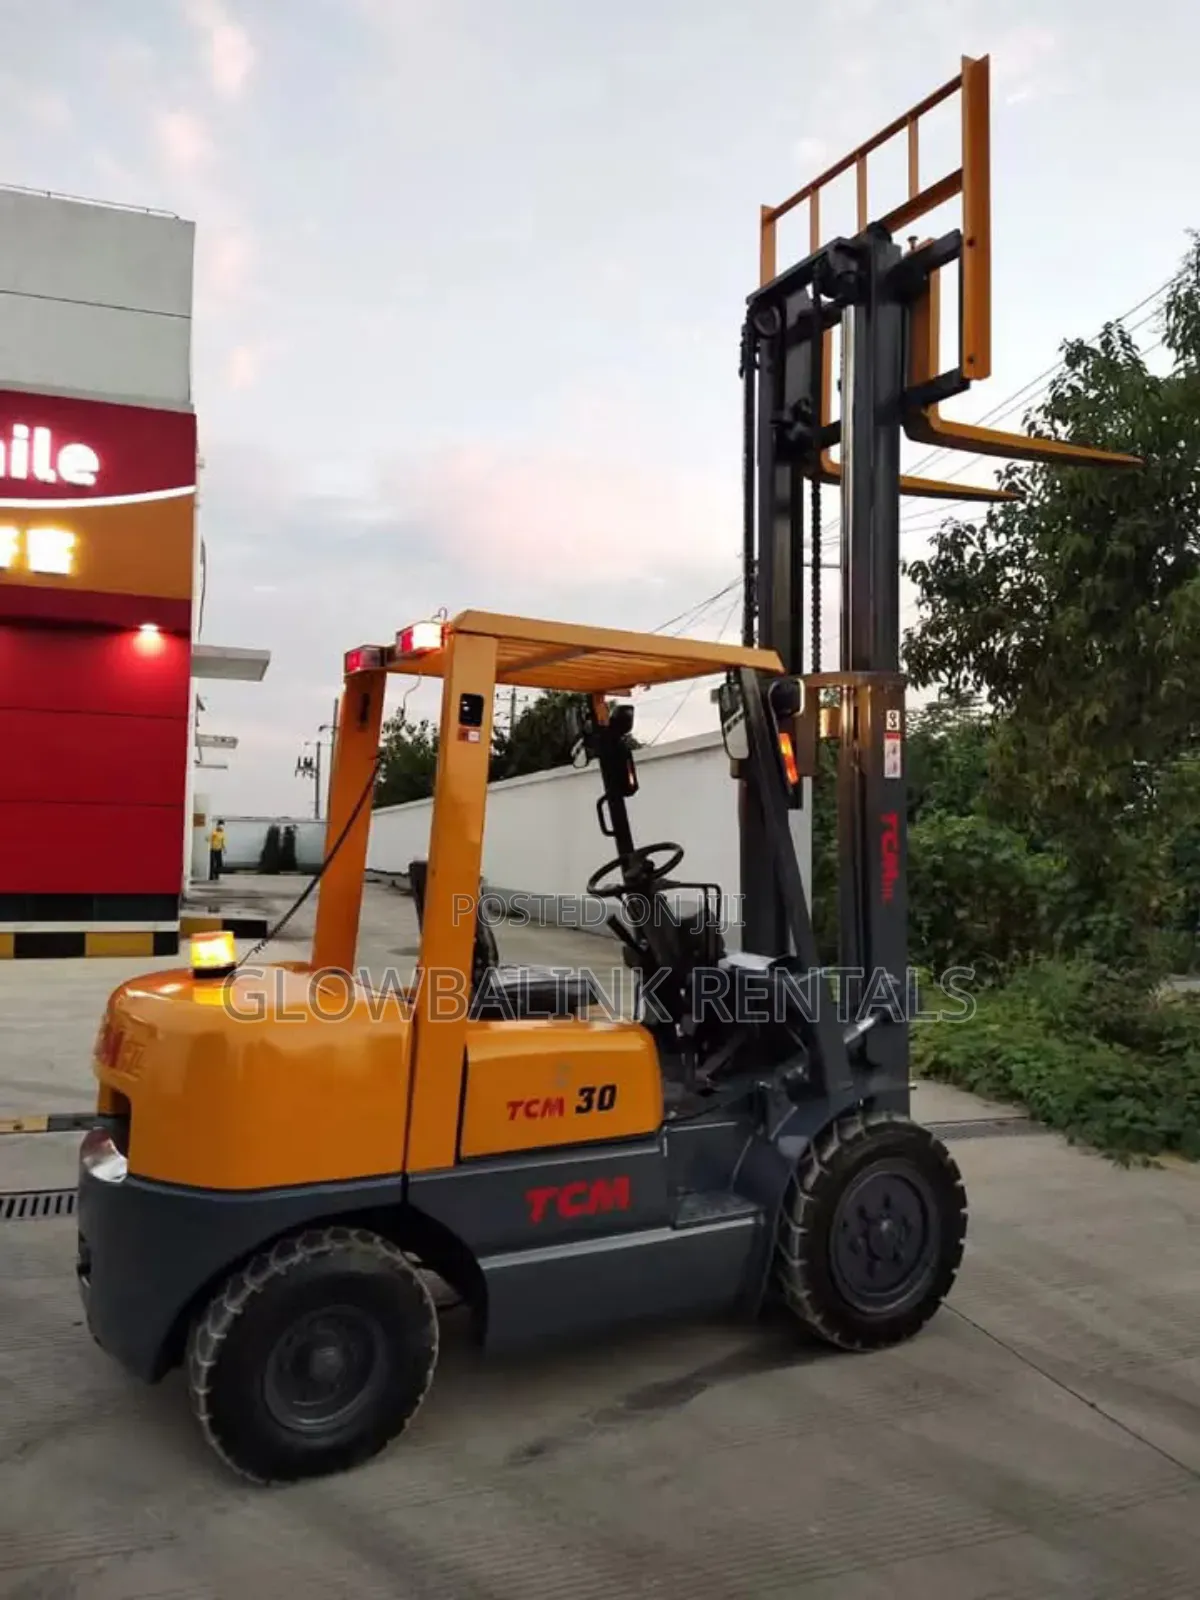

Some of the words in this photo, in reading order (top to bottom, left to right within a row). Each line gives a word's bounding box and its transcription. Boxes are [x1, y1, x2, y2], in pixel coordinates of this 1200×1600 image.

[0, 423, 100, 487] ile
[506, 1096, 565, 1121] TCM
[575, 1084, 618, 1115] 30
[524, 1174, 632, 1226] TCM
